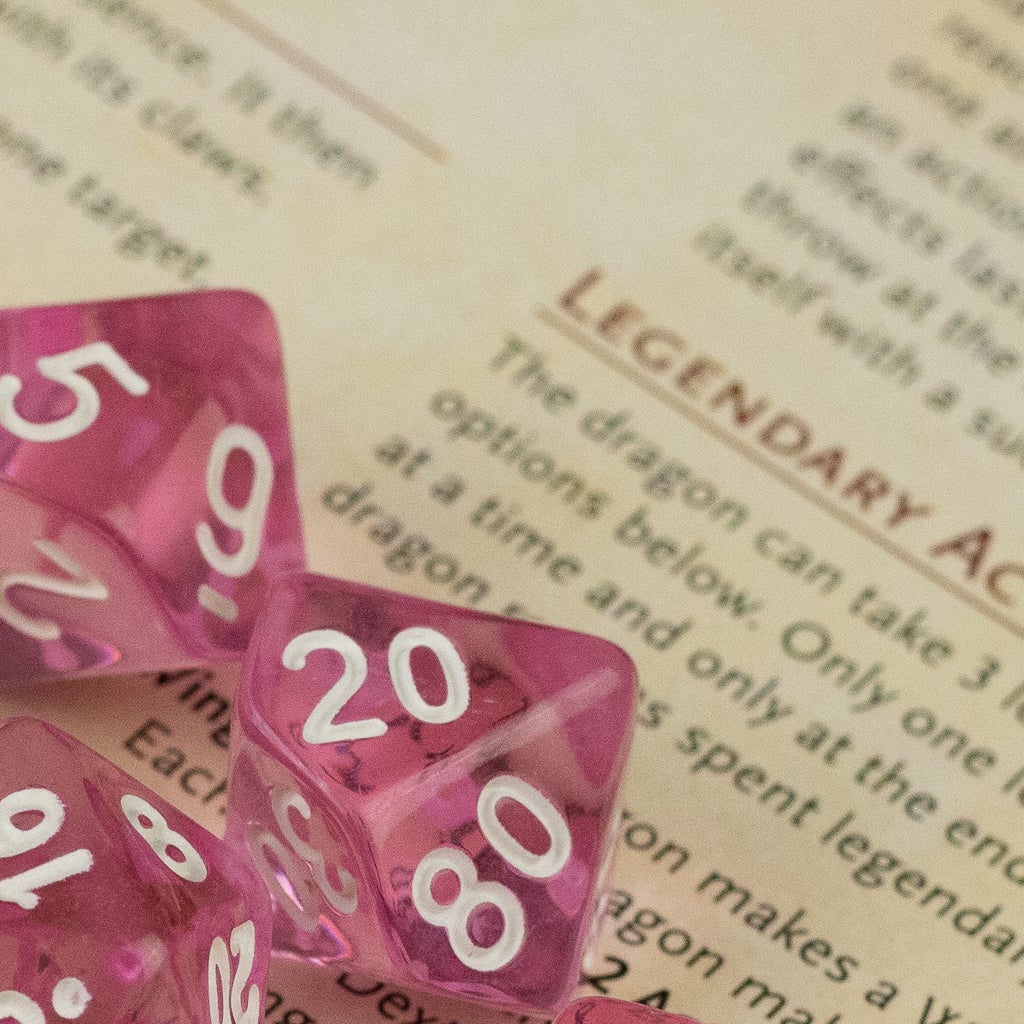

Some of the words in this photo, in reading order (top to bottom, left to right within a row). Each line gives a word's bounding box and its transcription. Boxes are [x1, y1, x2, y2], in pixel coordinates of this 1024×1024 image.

[558, 265, 934, 530] LEGENDARY
[321, 481, 491, 604] dragon
[429, 389, 609, 521] options
[613, 504, 761, 632] below.
[779, 618, 900, 715] Only
[901, 706, 998, 778] one
[490, 334, 577, 414] The
[579, 408, 750, 531] dragon
[753, 526, 845, 594] can
[849, 585, 954, 668] take
[957, 654, 1002, 691] 3
[281, 626, 471, 745] 20
[376, 434, 431, 481] at
[469, 495, 584, 586] time
[585, 579, 695, 653] and
[686, 650, 795, 732] only
[794, 721, 853, 767] at
[855, 754, 938, 823] the
[121, 794, 206, 882] 8
[675, 724, 820, 829] spent
[412, 775, 572, 973] 80
[696, 868, 860, 985] makes
[864, 979, 899, 1011] a
